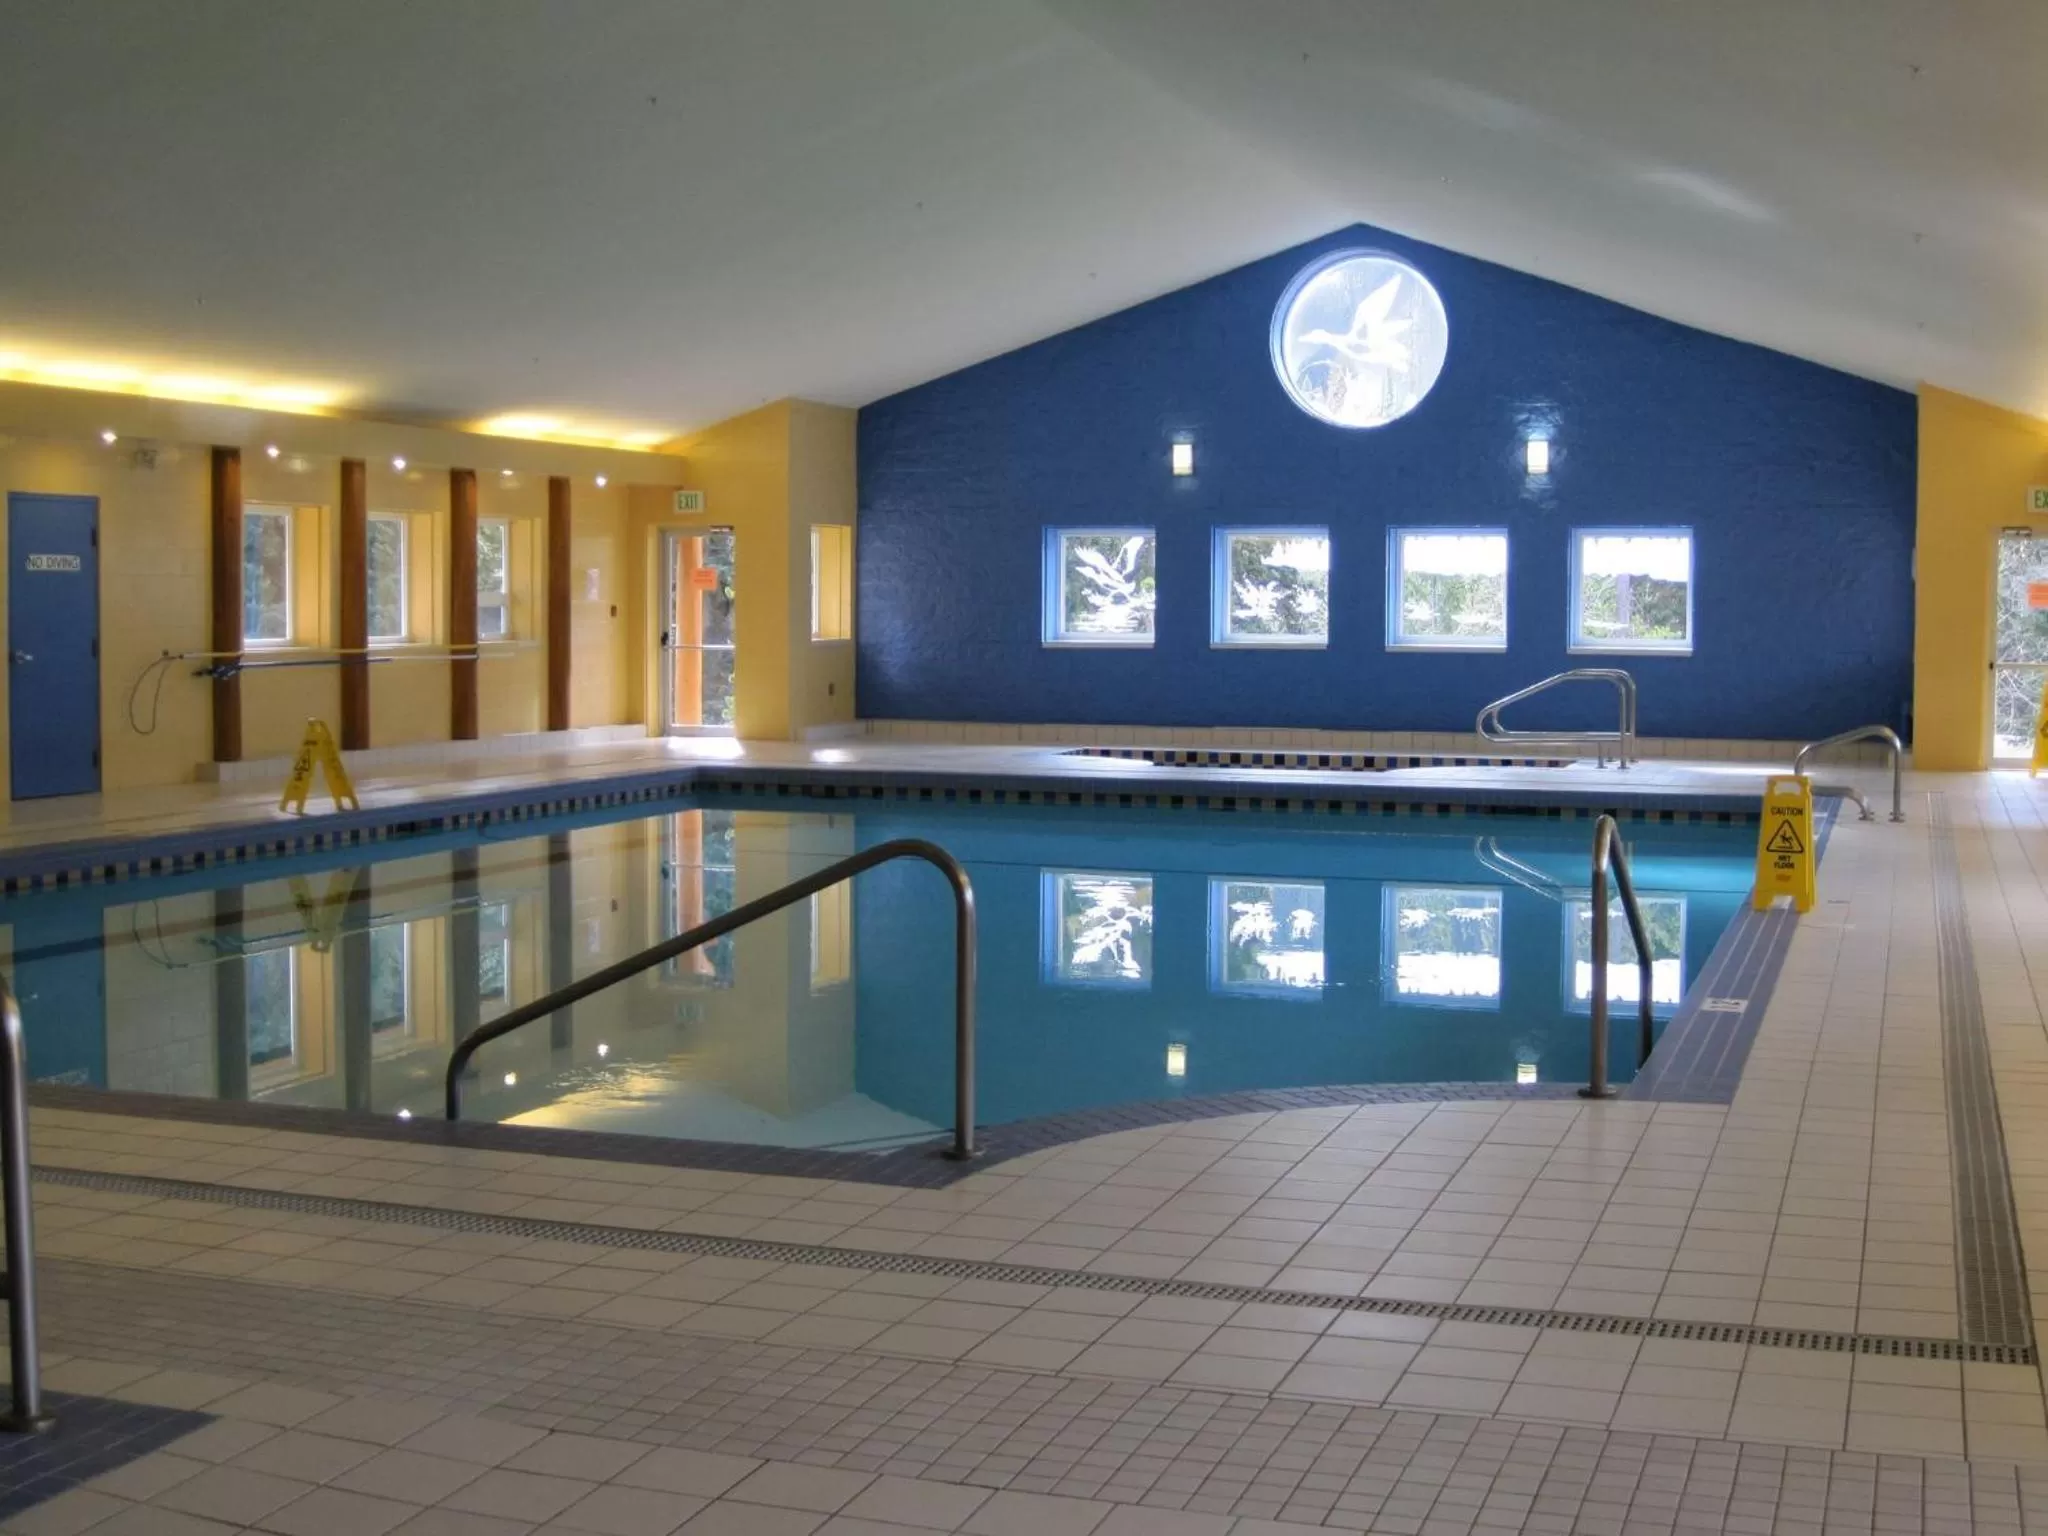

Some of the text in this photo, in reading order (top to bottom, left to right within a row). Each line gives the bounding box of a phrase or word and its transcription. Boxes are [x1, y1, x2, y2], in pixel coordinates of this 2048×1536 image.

[678, 493, 698, 509] EXIT
[27, 556, 78, 569] NO DIVING
[1771, 806, 1803, 816] CAUTION
